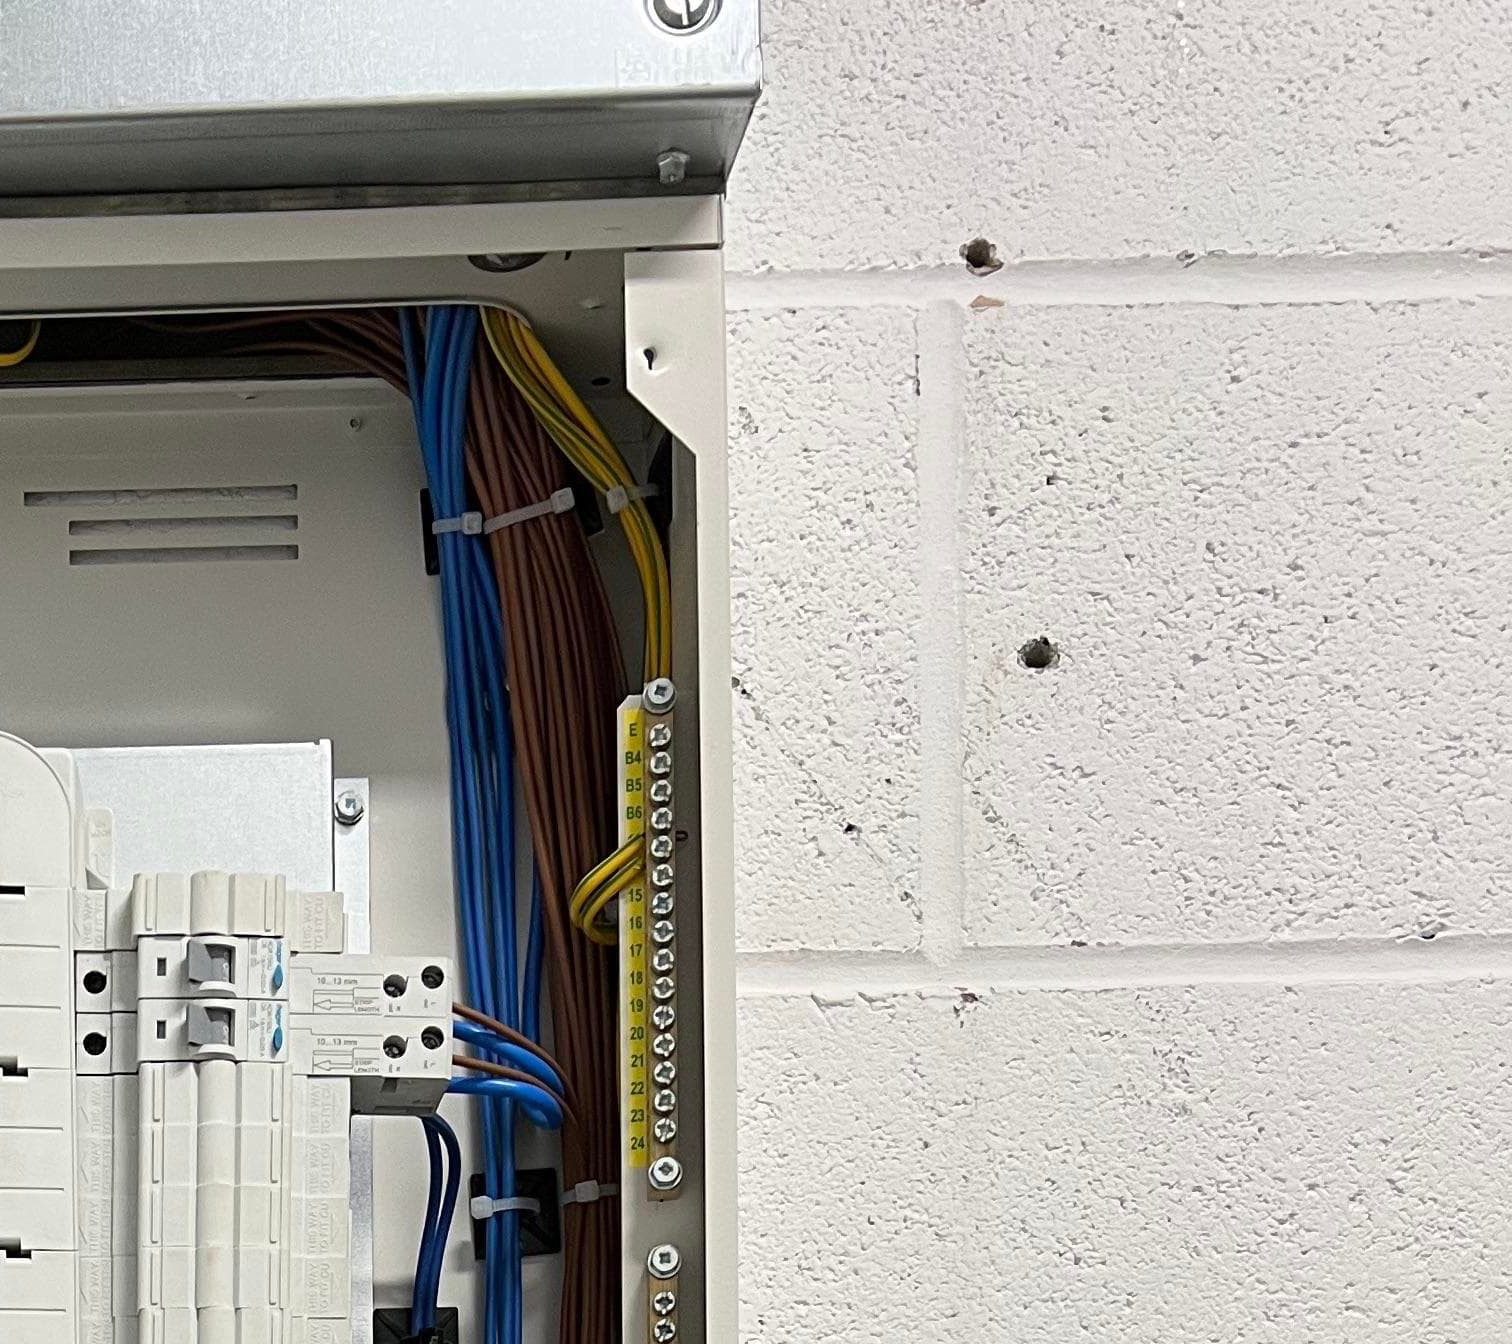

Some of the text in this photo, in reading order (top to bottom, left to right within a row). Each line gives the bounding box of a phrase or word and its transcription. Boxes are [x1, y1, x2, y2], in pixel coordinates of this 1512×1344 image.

[630, 723, 637, 736] E
[626, 752, 642, 764] B4
[626, 779, 642, 792] B5
[627, 806, 642, 819] B6
[629, 889, 642, 902] 15
[629, 916, 642, 929] 16
[629, 944, 642, 957] 17
[630, 971, 643, 985] 18
[630, 999, 643, 1012] 19
[630, 1026, 643, 1040] 20
[631, 1054, 644, 1067] 21
[631, 1081, 644, 1095] 22
[631, 1109, 644, 1122] 23
[631, 1136, 645, 1149] 24
